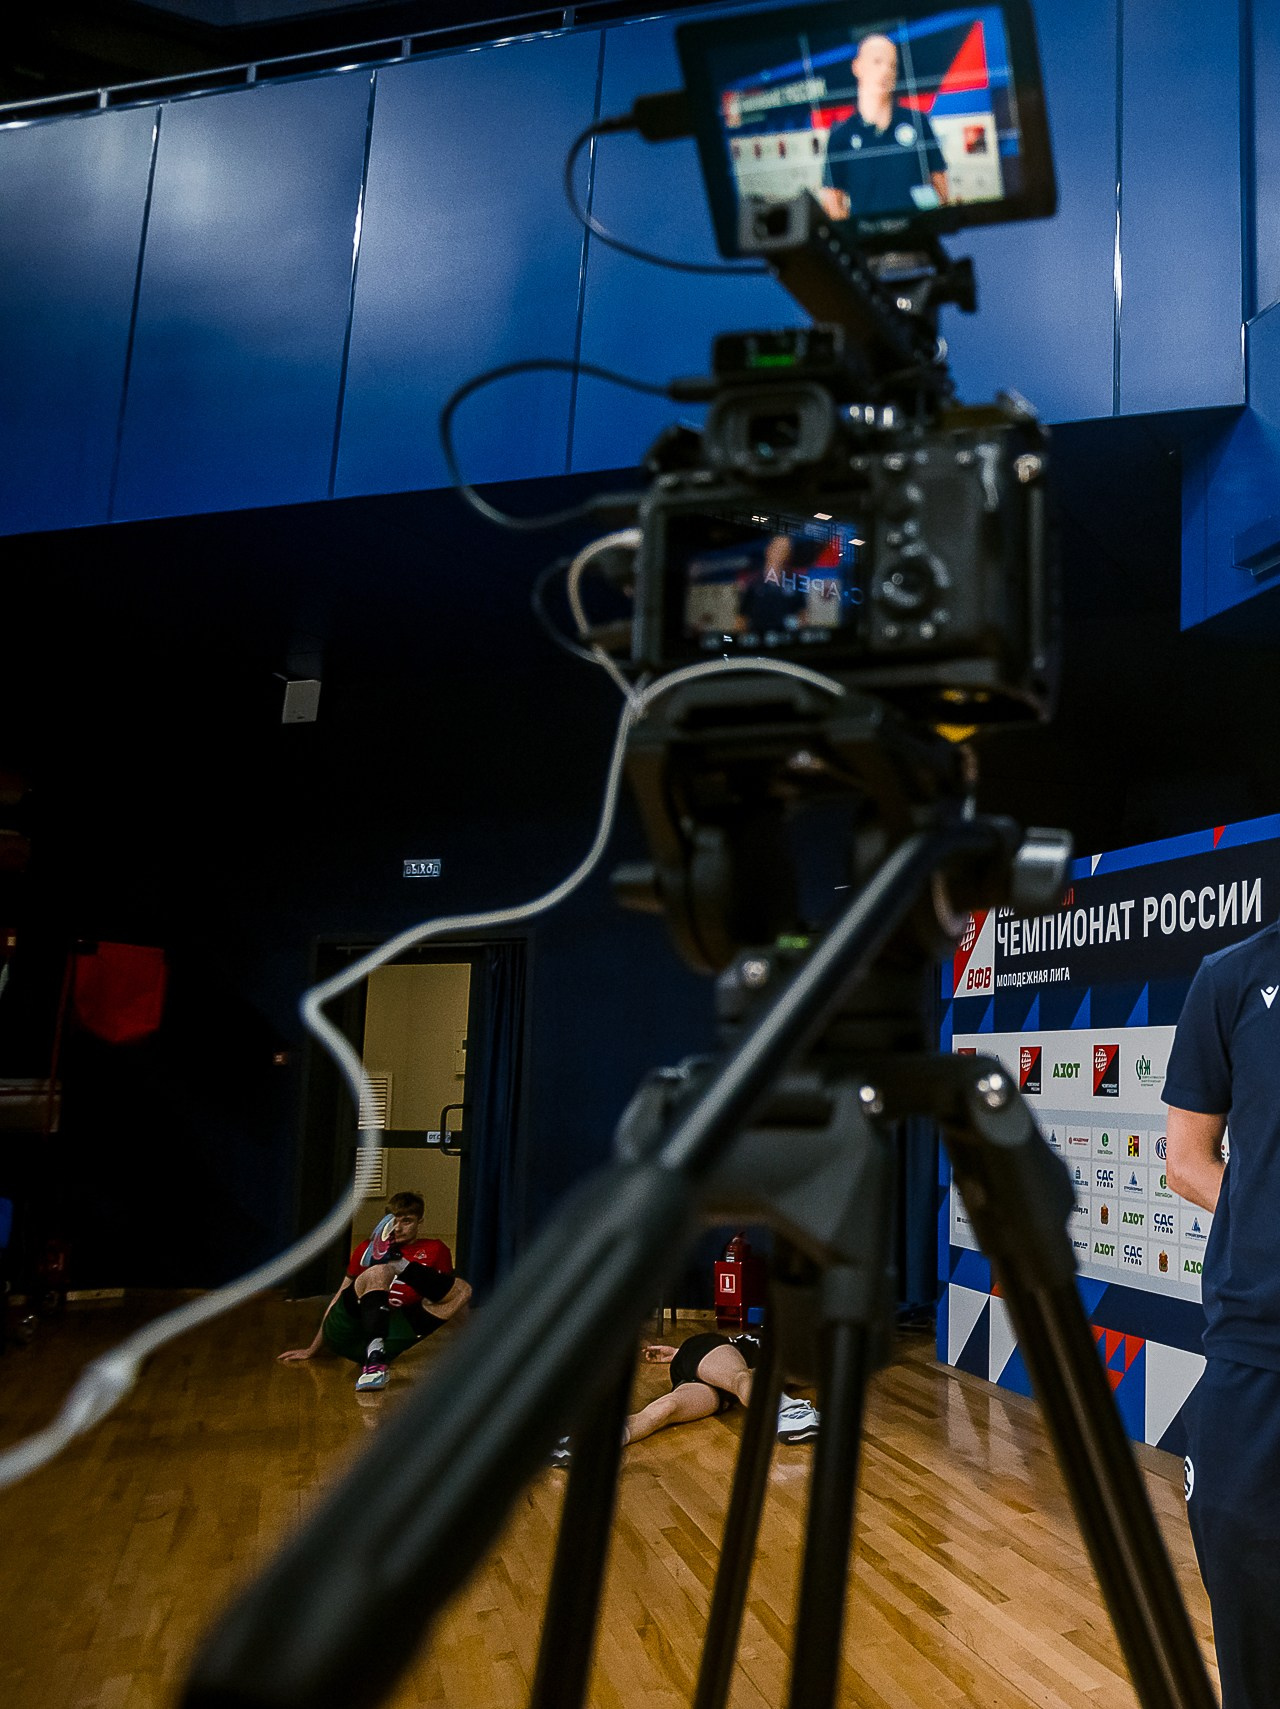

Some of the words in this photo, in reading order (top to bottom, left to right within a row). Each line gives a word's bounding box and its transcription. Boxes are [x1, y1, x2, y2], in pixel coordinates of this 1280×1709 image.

[405, 863, 440, 875] ВЫХОД
[997, 899, 1135, 957] ЧЕМПИОНАТ
[1143, 877, 1262, 937] РОССИИ
[966, 966, 992, 991] ВФВ
[996, 969, 1048, 988] МОЛОДЕЖНАЯ
[1049, 966, 1071, 983] ЛИГА
[1096, 1169, 1114, 1182] СДС
[1153, 1213, 1174, 1227] СДС
[1153, 1225, 1174, 1235] УГОЛЬ
[1123, 1244, 1143, 1259] СДС
[1183, 1259, 1203, 1275] АЗО
